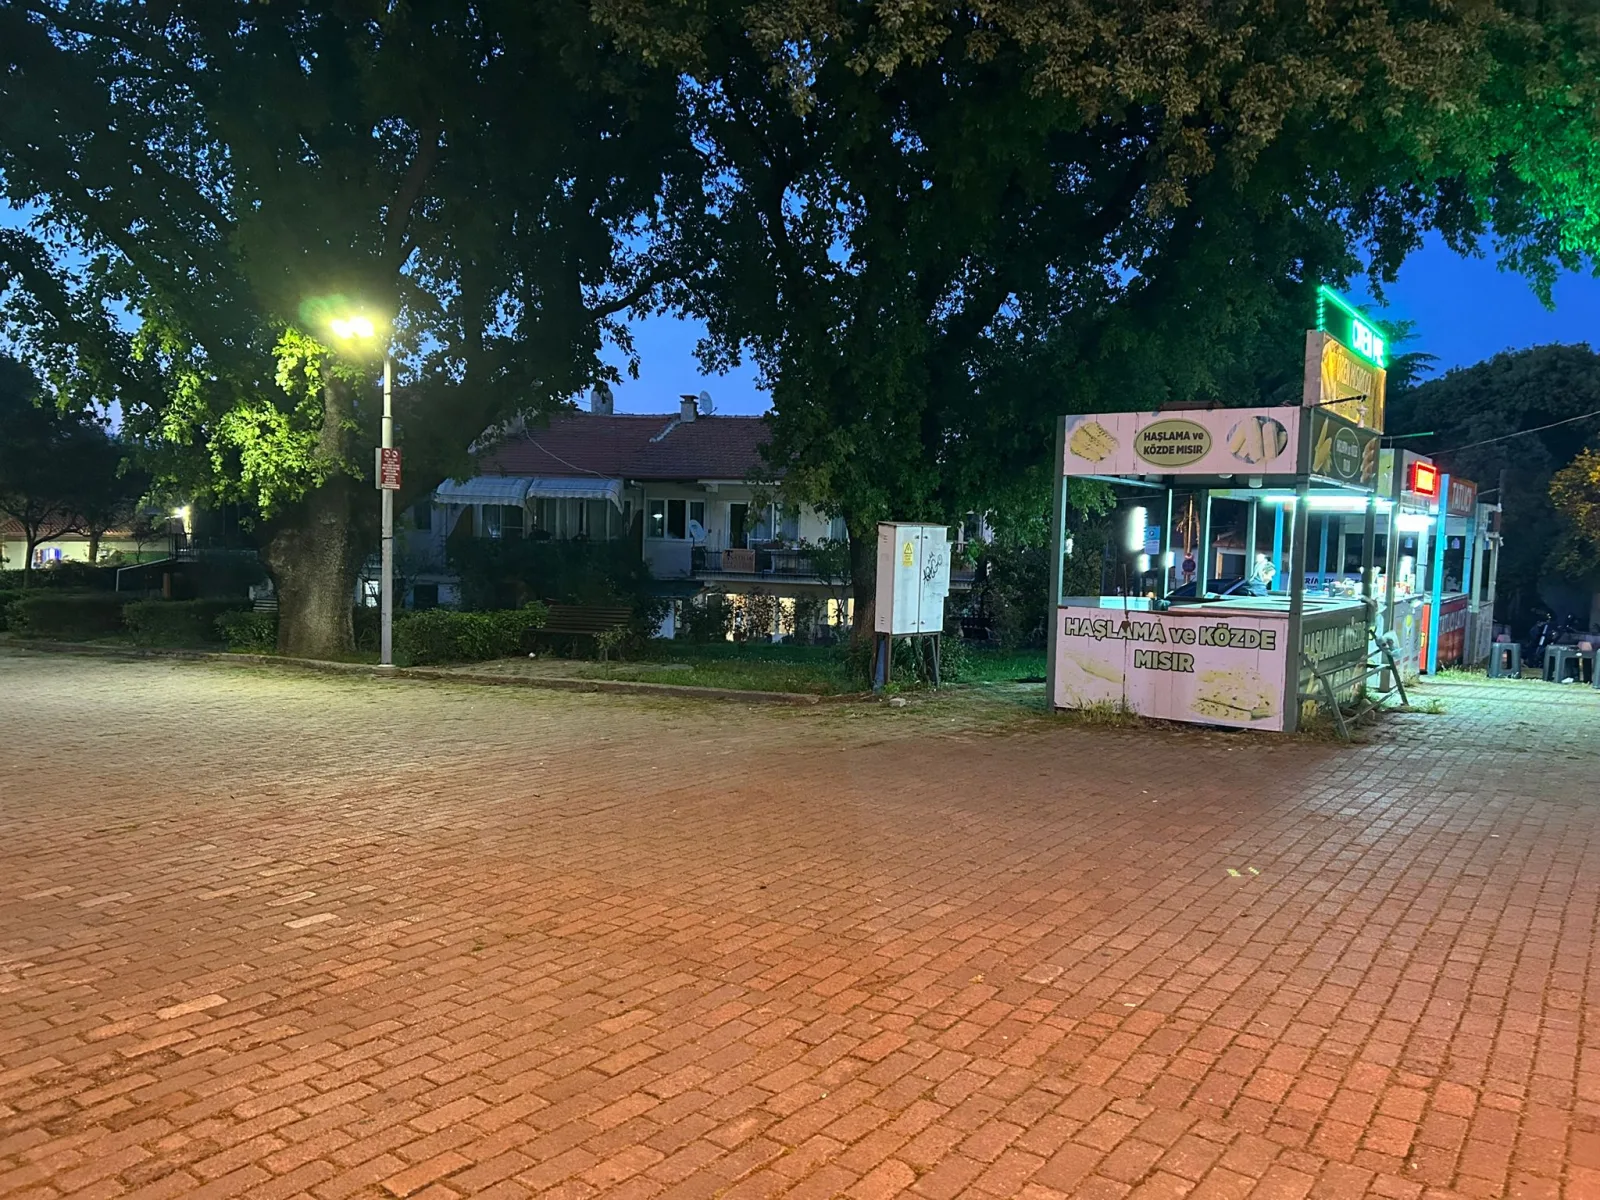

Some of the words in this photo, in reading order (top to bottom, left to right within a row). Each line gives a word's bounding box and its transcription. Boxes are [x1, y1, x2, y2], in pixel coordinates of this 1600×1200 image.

[1143, 431, 1191, 442] HAŞLAMA
[1193, 432, 1204, 440] ve
[1143, 443, 1175, 455] KÖZDE
[1176, 445, 1203, 455] MISIR
[1065, 617, 1166, 642] HAŞLAMA
[1169, 627, 1196, 645] ve
[1199, 623, 1276, 650] KÖZDE
[1134, 649, 1194, 673] MISIR
